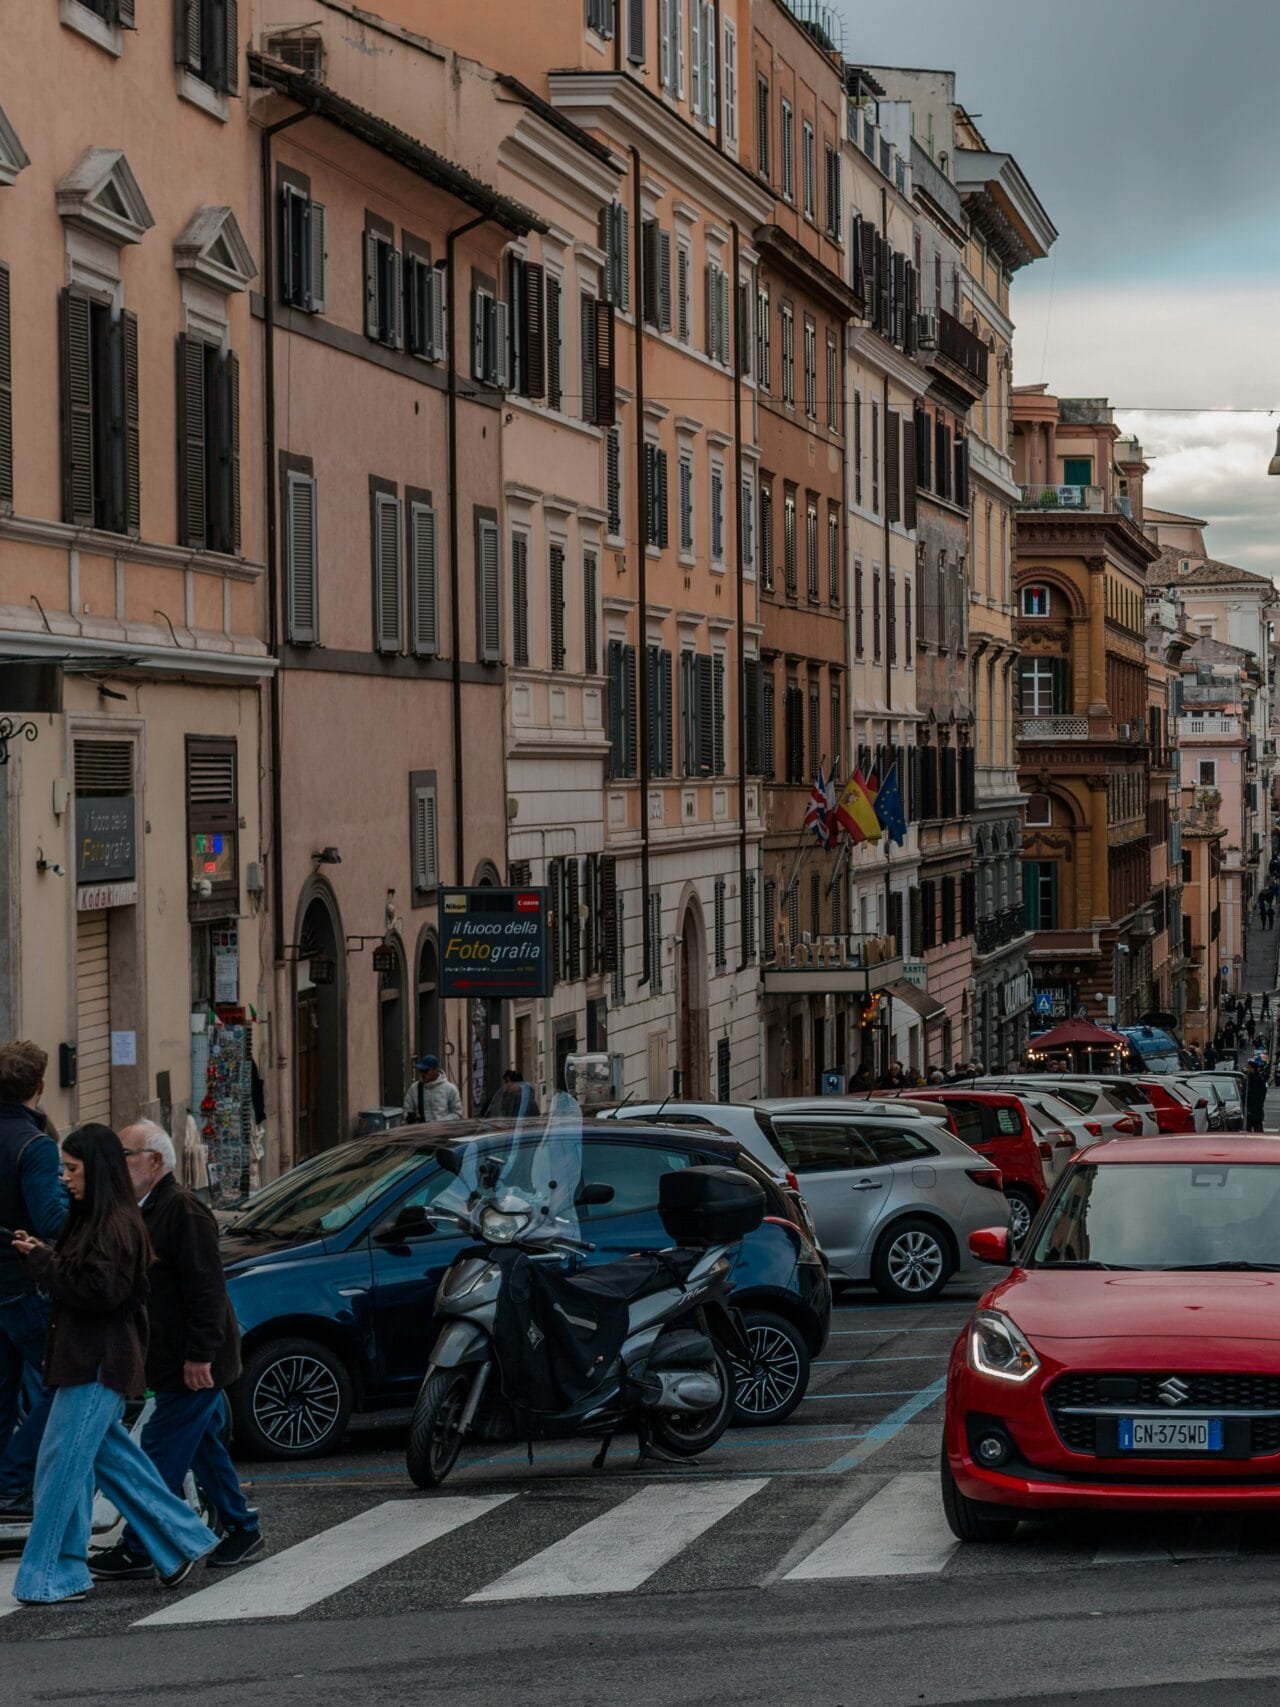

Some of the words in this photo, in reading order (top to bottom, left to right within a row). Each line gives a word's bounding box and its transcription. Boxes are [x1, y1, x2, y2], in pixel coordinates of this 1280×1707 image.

[81, 886, 112, 909] Kodak
[452, 921, 461, 935] il
[462, 920, 502, 935] fuoco
[504, 920, 538, 935] della
[445, 938, 541, 963] Fotografia
